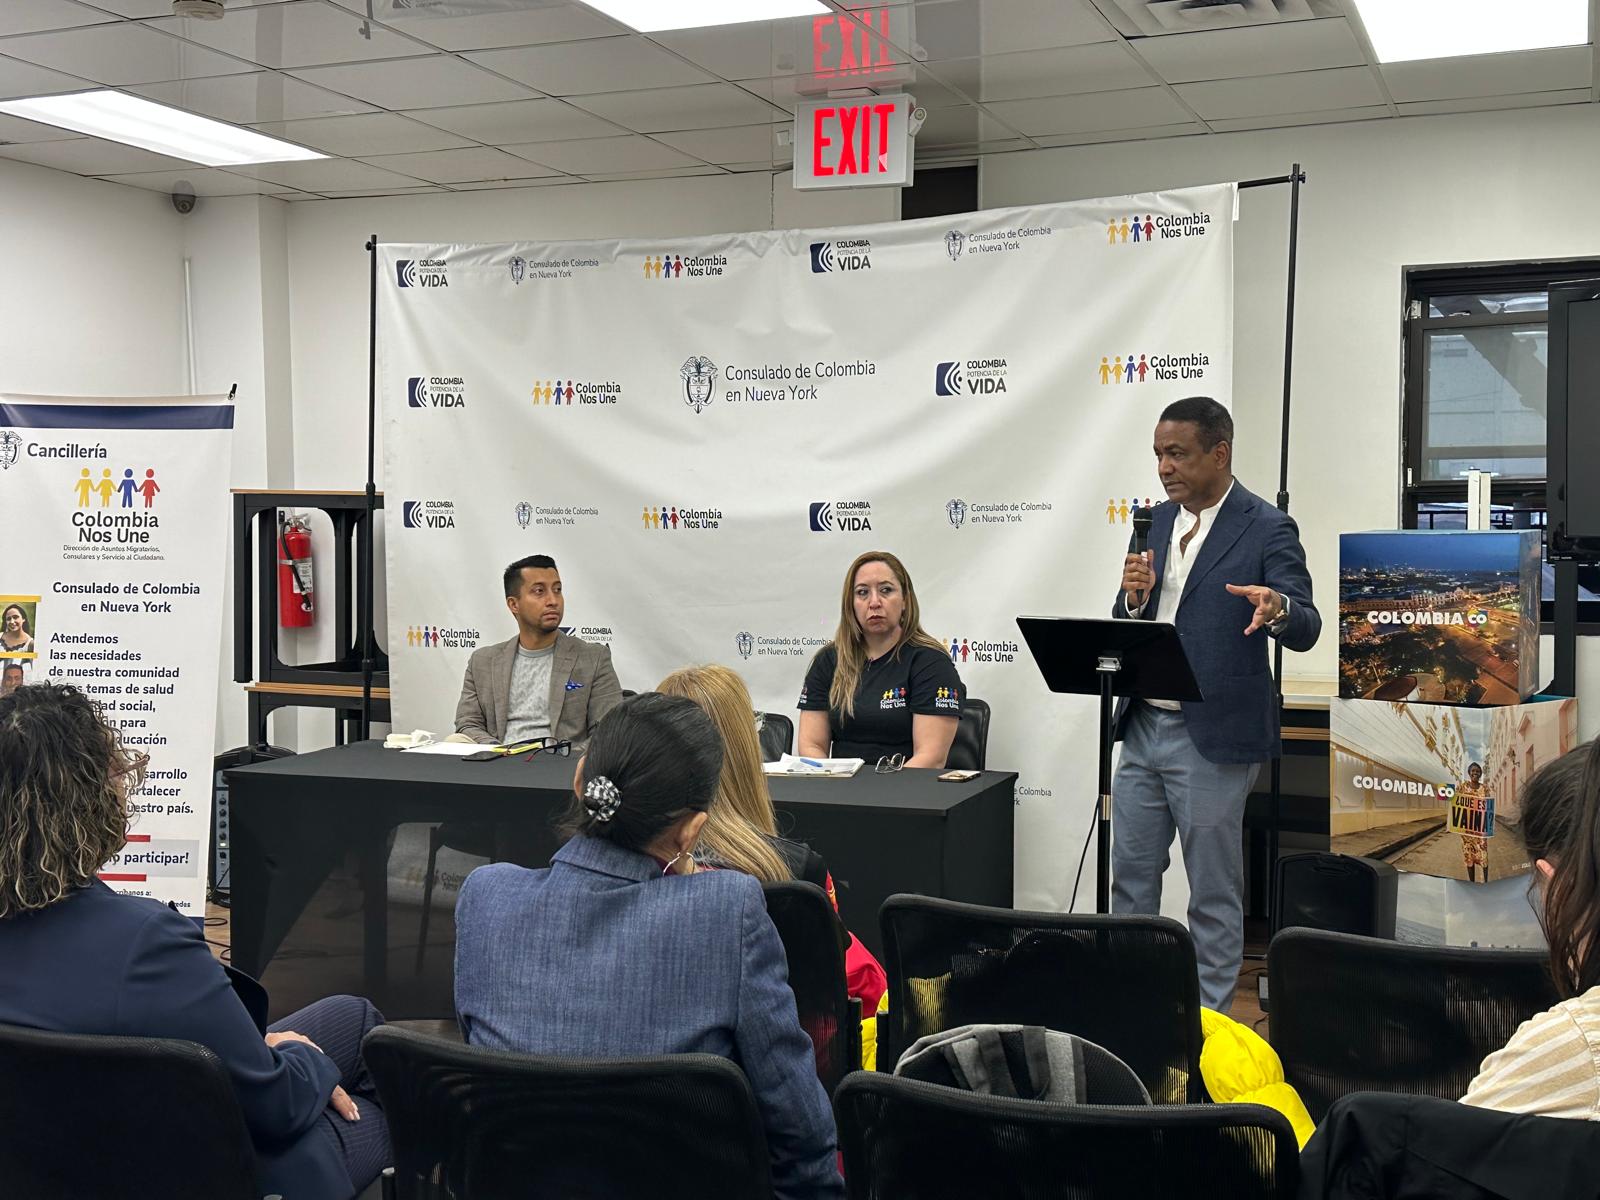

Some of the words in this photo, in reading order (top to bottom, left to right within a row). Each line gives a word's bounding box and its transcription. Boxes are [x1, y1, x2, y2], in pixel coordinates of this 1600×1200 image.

[814, 104, 895, 177] EXIT
[1156, 212, 1210, 228] Colombia
[969, 232, 1006, 242] Consulado
[1008, 230, 1016, 239] de
[1018, 226, 1051, 237] Colombia
[1161, 227, 1181, 239] Nos
[1184, 225, 1205, 237] Une
[836, 240, 870, 249] COLOMBIA
[980, 243, 1002, 253] Nueva
[1004, 241, 1020, 251] York
[530, 260, 560, 269] Consulado
[562, 260, 569, 268] de
[571, 259, 599, 267] Colombia
[684, 255, 727, 267] Colombia
[838, 255, 871, 271] VIDA
[539, 271, 557, 279] Nueva
[559, 270, 572, 278] York
[687, 266, 702, 277] Nos
[705, 265, 723, 276] Une
[420, 275, 448, 287] VIDA
[967, 359, 1007, 369] COLOMBIA
[1150, 353, 1210, 368] Colombia
[726, 364, 792, 382] Consulado
[795, 363, 811, 379] de
[815, 361, 876, 378] Colombia
[1156, 368, 1177, 380] Nos
[1181, 366, 1204, 379] Une
[430, 377, 464, 385] COLOMBIA
[967, 378, 1007, 395] VIDA
[576, 383, 621, 394] Colombia
[726, 390, 742, 402] en
[745, 387, 784, 402] Nueva
[788, 385, 818, 401] York
[430, 394, 465, 408] VIDA
[580, 394, 597, 405] Nos
[599, 394, 616, 404] Une
[27, 442, 107, 459] Cancillería
[536, 507, 563, 515] Consulado
[565, 507, 572, 515] de
[573, 508, 599, 516] Colombia
[836, 502, 870, 510] COLOMBIA
[971, 503, 1008, 513] Consulado
[1010, 503, 1018, 512] de
[1021, 502, 1052, 512] Colombia
[72, 512, 159, 528] Colombia
[680, 508, 722, 520] Colombia
[982, 514, 1004, 523] Nueva
[1006, 513, 1022, 523] York
[426, 516, 455, 529] VIDA
[684, 519, 700, 529] Nos
[702, 519, 719, 529] Une
[838, 517, 872, 531] VIDA
[79, 528, 112, 543] Nos
[118, 528, 150, 543] Une
[64, 544, 90, 552] Dirección
[92, 544, 99, 552] de
[53, 582, 119, 594] Consulado
[124, 582, 138, 594] de
[143, 583, 200, 595] Colombia
[81, 603, 96, 612] en
[101, 601, 138, 613] Nueva
[143, 602, 172, 613] York
[1368, 611, 1464, 625] COLOMBIA
[50, 633, 119, 644] Atendemos
[440, 628, 480, 639] Colombia
[444, 638, 460, 648] Nos
[462, 638, 476, 648] Une
[758, 636, 791, 645] Consulado
[793, 637, 801, 645] de
[972, 641, 1018, 652] Colombia
[50, 649, 66, 660] las
[70, 650, 142, 661] necesidades
[768, 648, 787, 656] Nueva
[789, 648, 804, 656] York
[975, 652, 992, 662] Nos
[995, 652, 1013, 662] Une
[49, 666, 63, 676] de
[67, 667, 111, 677] nuestra
[115, 667, 180, 678] comunidad
[86, 684, 122, 694] temas
[126, 684, 140, 694] de
[143, 684, 174, 694] salud
[120, 700, 156, 712] social,
[120, 719, 146, 729] para
[118, 733, 167, 745] ucación
[144, 768, 187, 780] sarrollo
[1019, 787, 1052, 796] Colombia
[1353, 775, 1434, 797] COLOMBIA
[127, 803, 164, 813] uestro
[167, 802, 194, 815] país.
[124, 852, 189, 866] participar!
